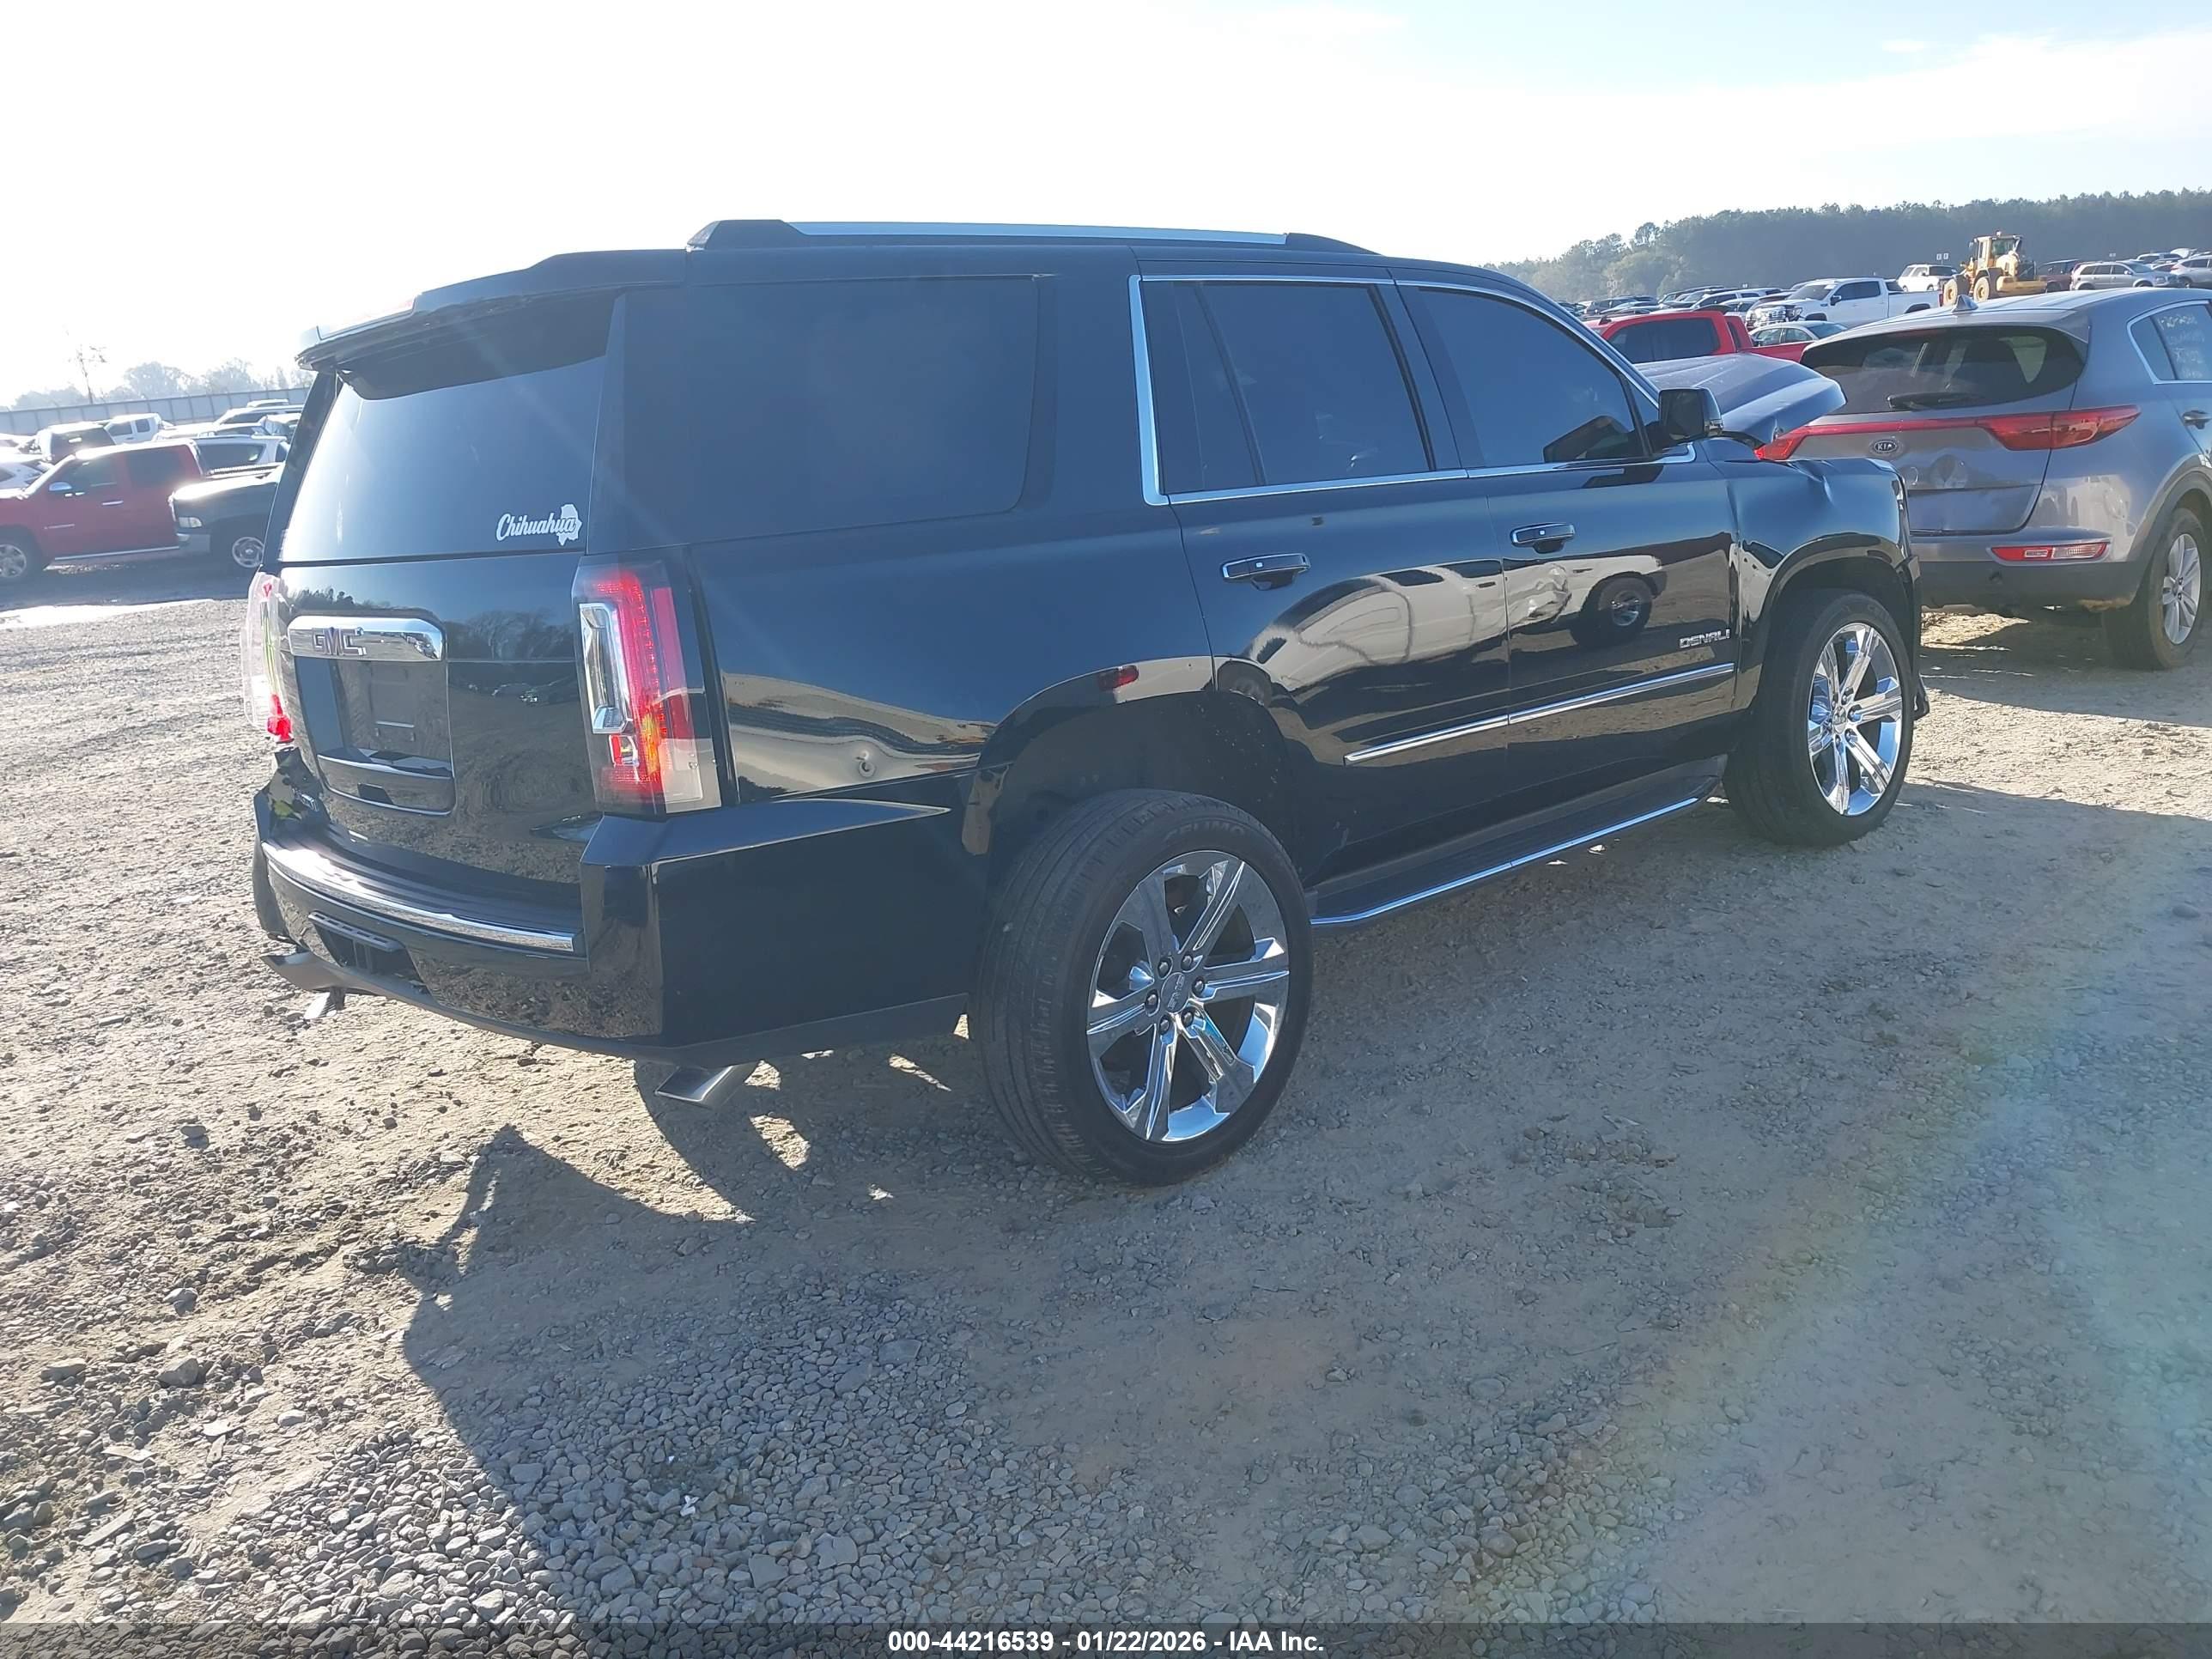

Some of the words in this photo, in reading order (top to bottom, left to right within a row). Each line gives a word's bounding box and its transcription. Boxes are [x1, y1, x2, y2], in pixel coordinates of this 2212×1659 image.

[495, 513, 577, 541] Chihuahua
[312, 628, 368, 656] GMC
[1679, 629, 1730, 648] DENALI
